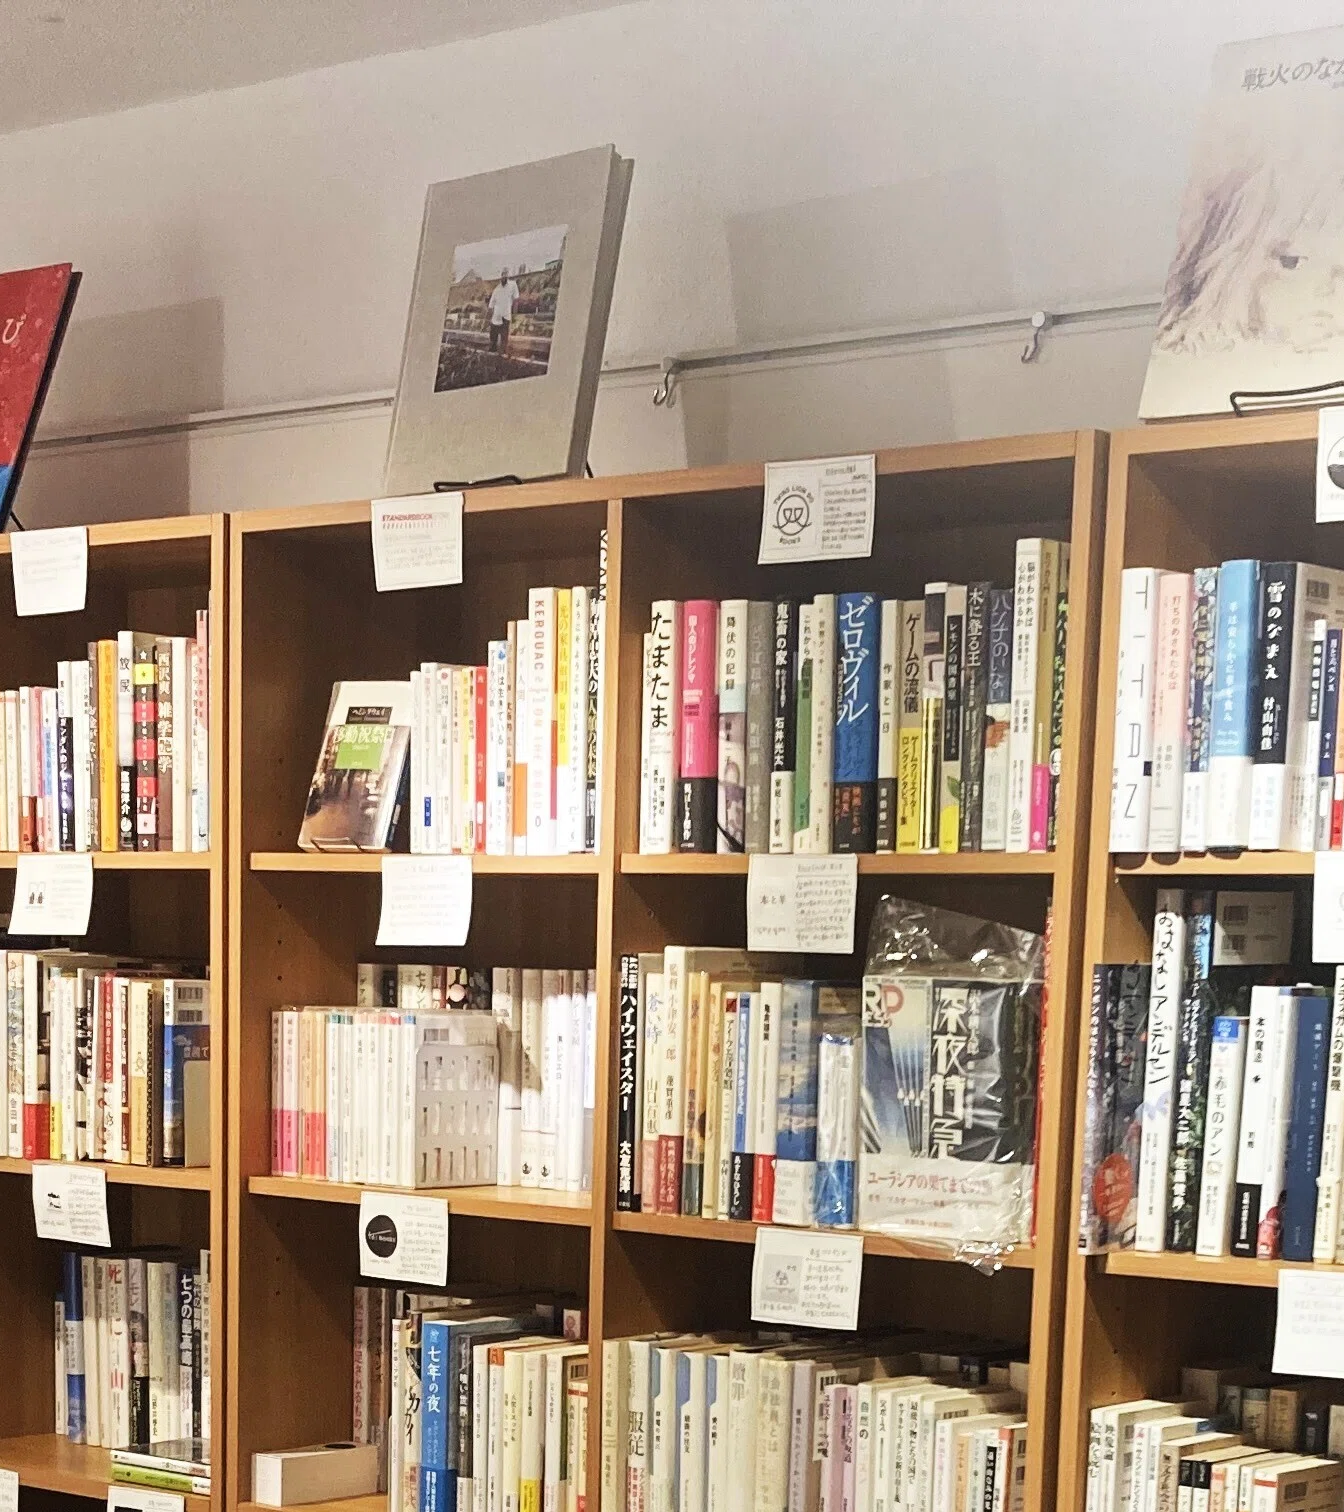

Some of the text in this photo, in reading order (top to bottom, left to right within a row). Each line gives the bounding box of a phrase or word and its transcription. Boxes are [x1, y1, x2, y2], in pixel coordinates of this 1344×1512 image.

[534, 599, 545, 671] KEROUAC
[650, 612, 673, 728] たまたま
[725, 616, 736, 691] 降伏の記録
[775, 603, 789, 665] 鬼畜の家
[837, 595, 874, 727] ゼロヴィル
[904, 612, 922, 714] ゲームの流儀
[1264, 580, 1286, 681] 雪のなまえ
[909, 736, 918, 818] ゲームクリエイター
[619, 993, 637, 1112] ハイウェイスター
[928, 987, 970, 1162] 深夜特急
[619, 1140, 632, 1194] 大友克洋
[427, 1344, 442, 1414] 七年の夜
[625, 1410, 646, 1457] 服従
